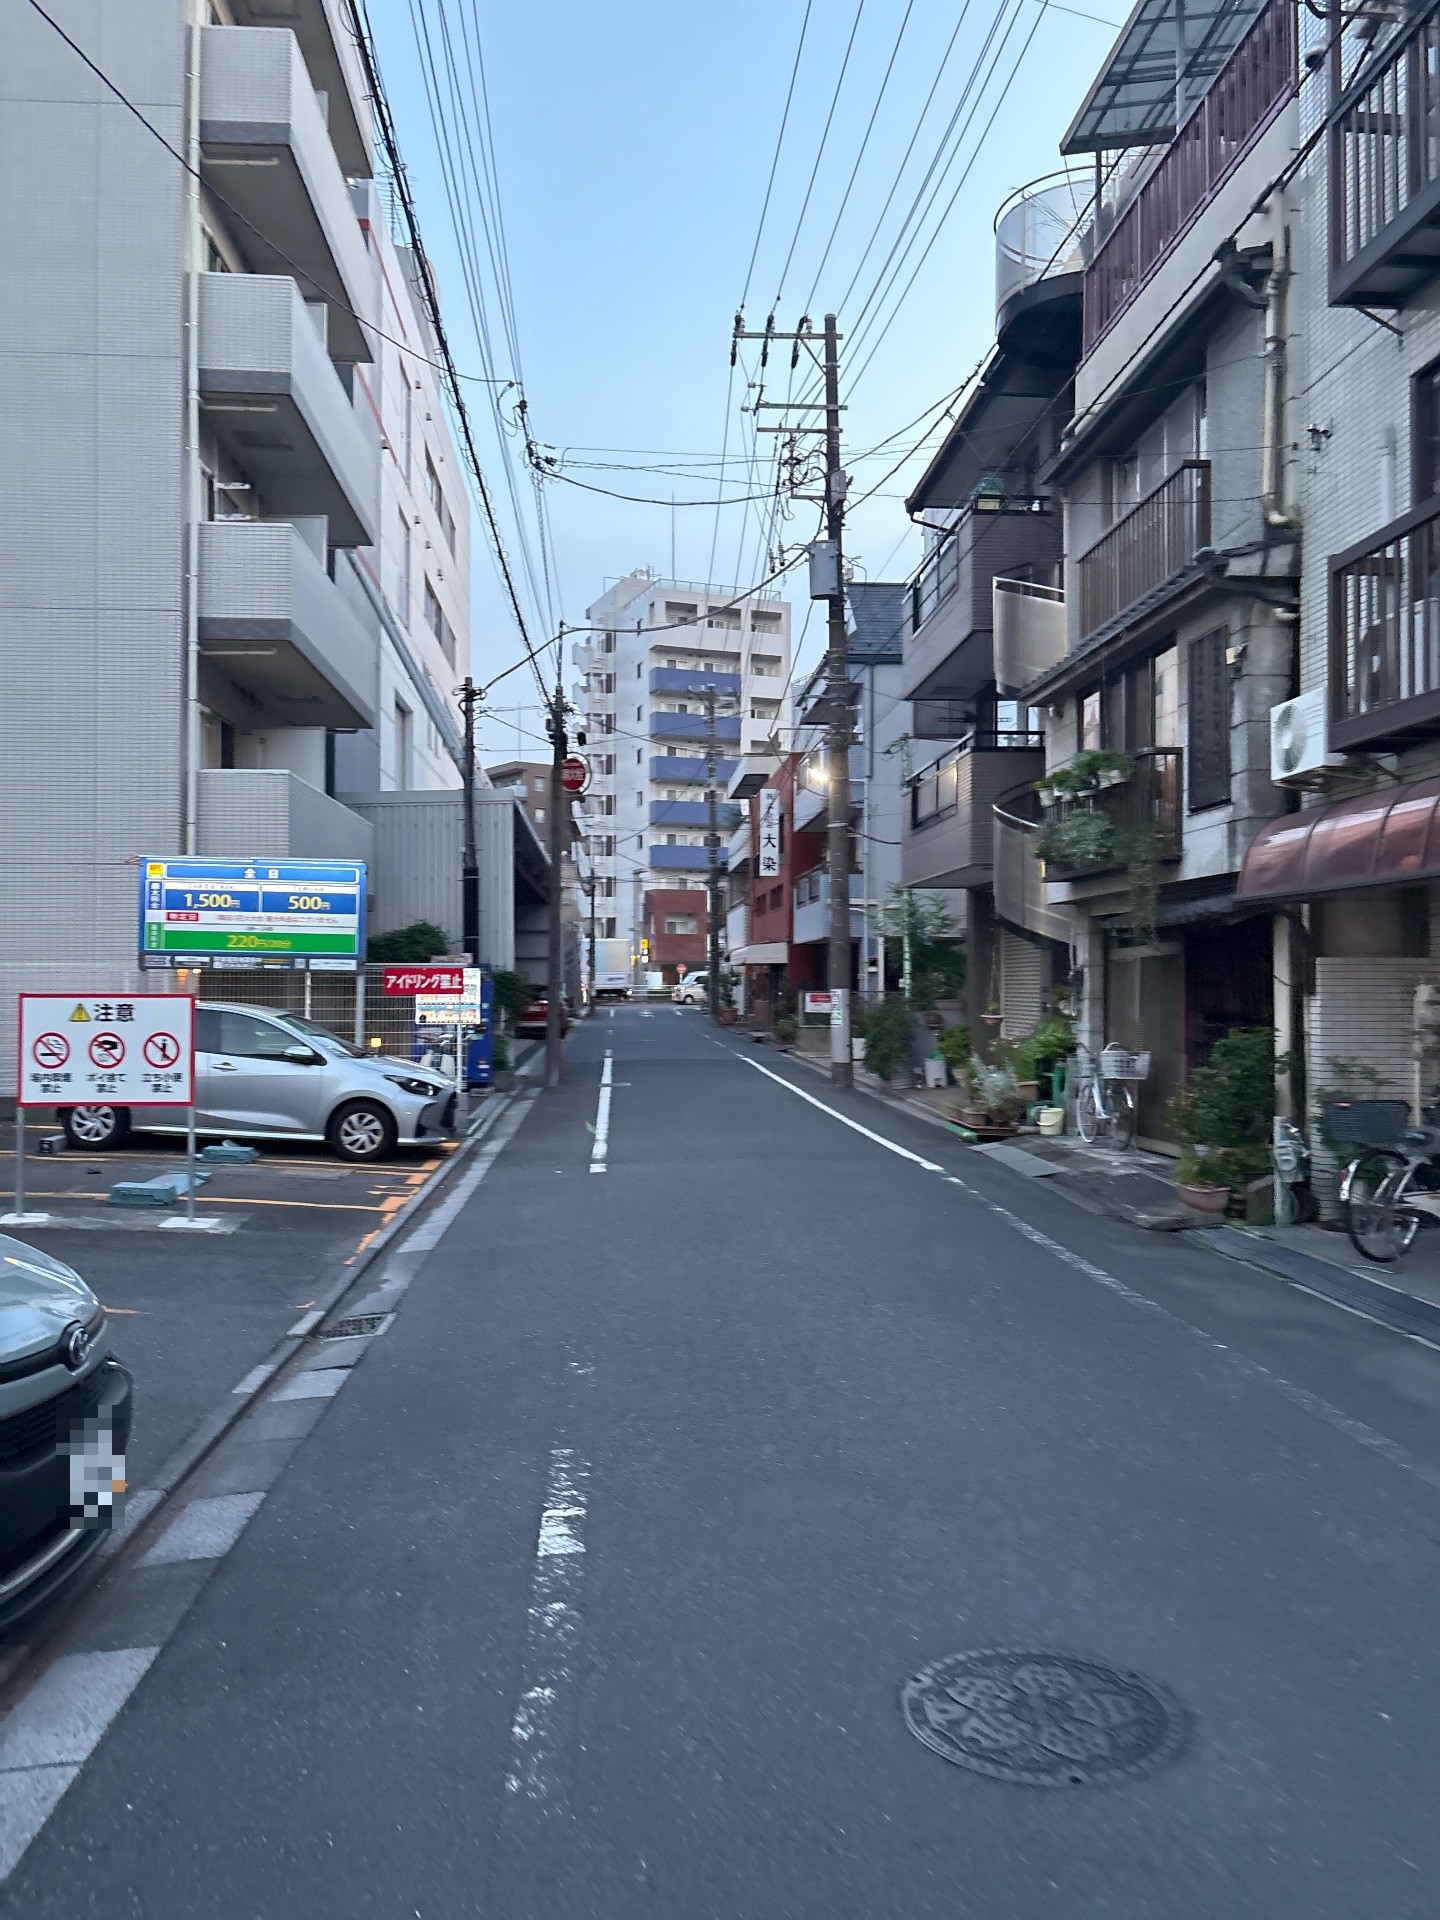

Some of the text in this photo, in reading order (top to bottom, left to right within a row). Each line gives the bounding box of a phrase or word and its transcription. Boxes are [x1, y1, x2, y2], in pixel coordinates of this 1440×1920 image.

[183, 893, 241, 909] 1,500円
[288, 895, 331, 911] 500円
[385, 974, 463, 989] アイドリング禁止
[93, 1003, 136, 1022] 注意
[85, 1072, 128, 1083] ポイ捨て
[141, 1072, 184, 1083] 立ち小便
[40, 1083, 63, 1094] 禁止
[95, 1083, 119, 1094] 禁止
[151, 1083, 174, 1094] 禁止
